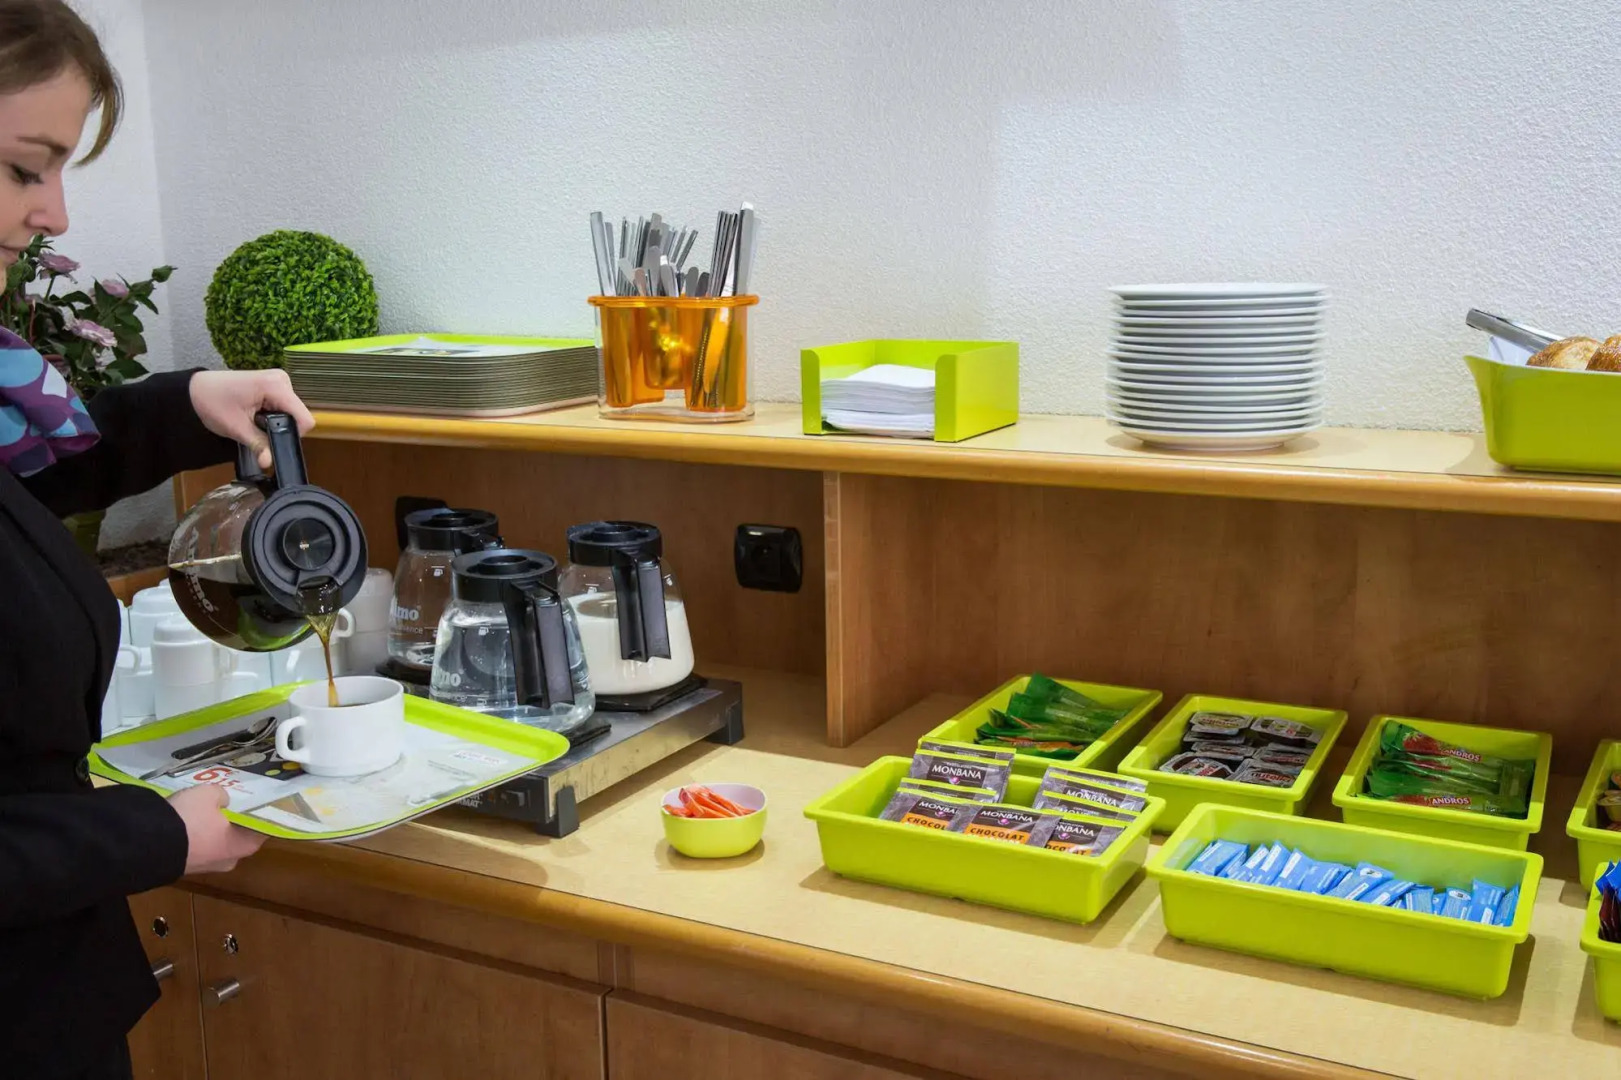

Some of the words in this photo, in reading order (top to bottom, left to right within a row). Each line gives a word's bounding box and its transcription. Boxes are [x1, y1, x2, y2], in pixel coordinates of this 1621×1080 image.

[1443, 749, 1480, 762] ANDROS
[931, 764, 982, 780] MONBANA
[1431, 797, 1470, 805] ANDROS
[980, 810, 1034, 823] MONBANA
[969, 827, 1026, 841] CHOCOLAT
